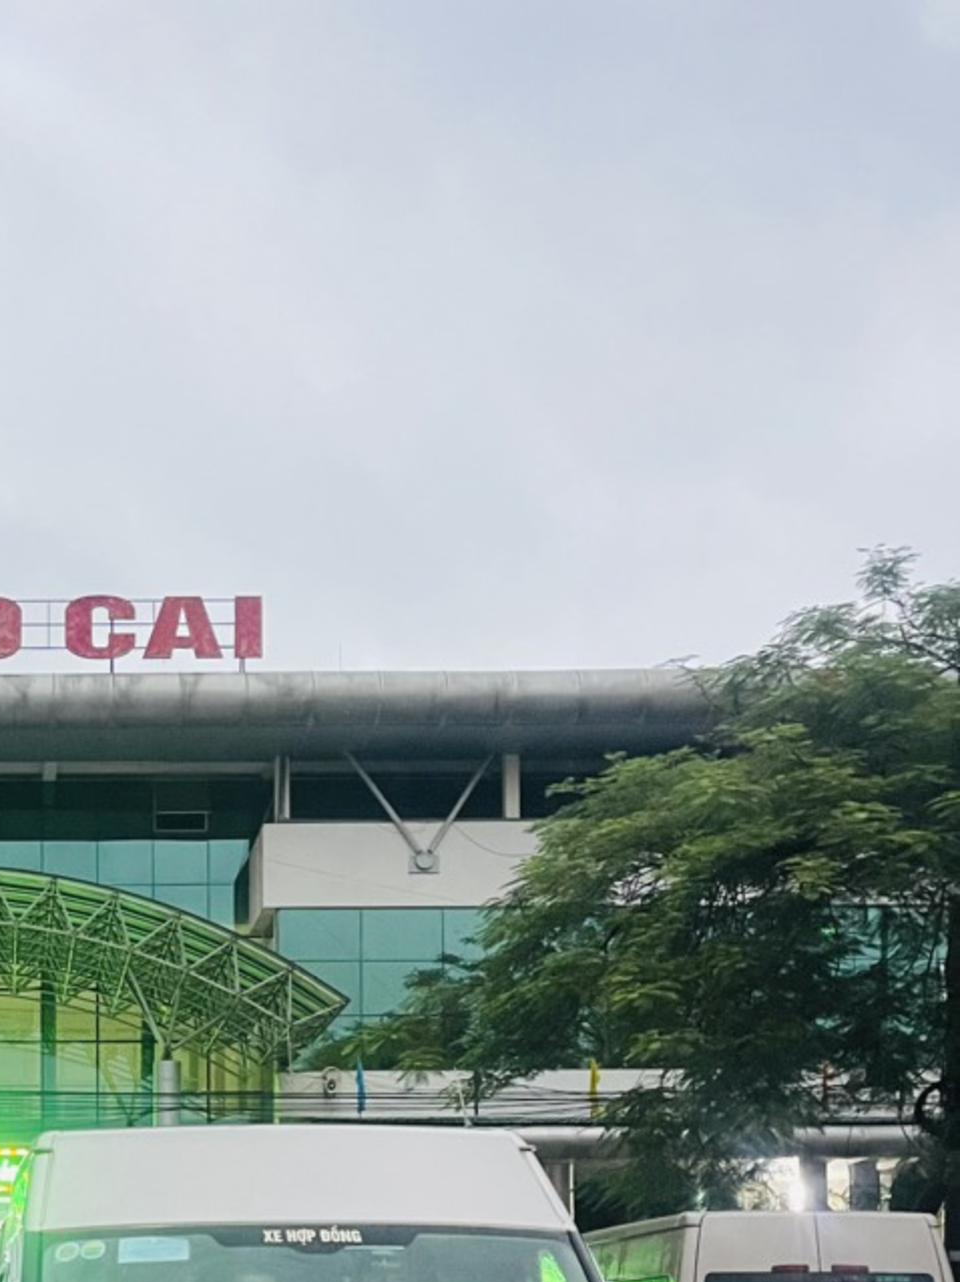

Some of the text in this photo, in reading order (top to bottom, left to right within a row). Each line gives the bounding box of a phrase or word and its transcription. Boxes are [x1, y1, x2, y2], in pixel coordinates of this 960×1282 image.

[65, 594, 263, 660] CAI
[263, 1229, 283, 1242] XE
[285, 1228, 316, 1246] HỢP
